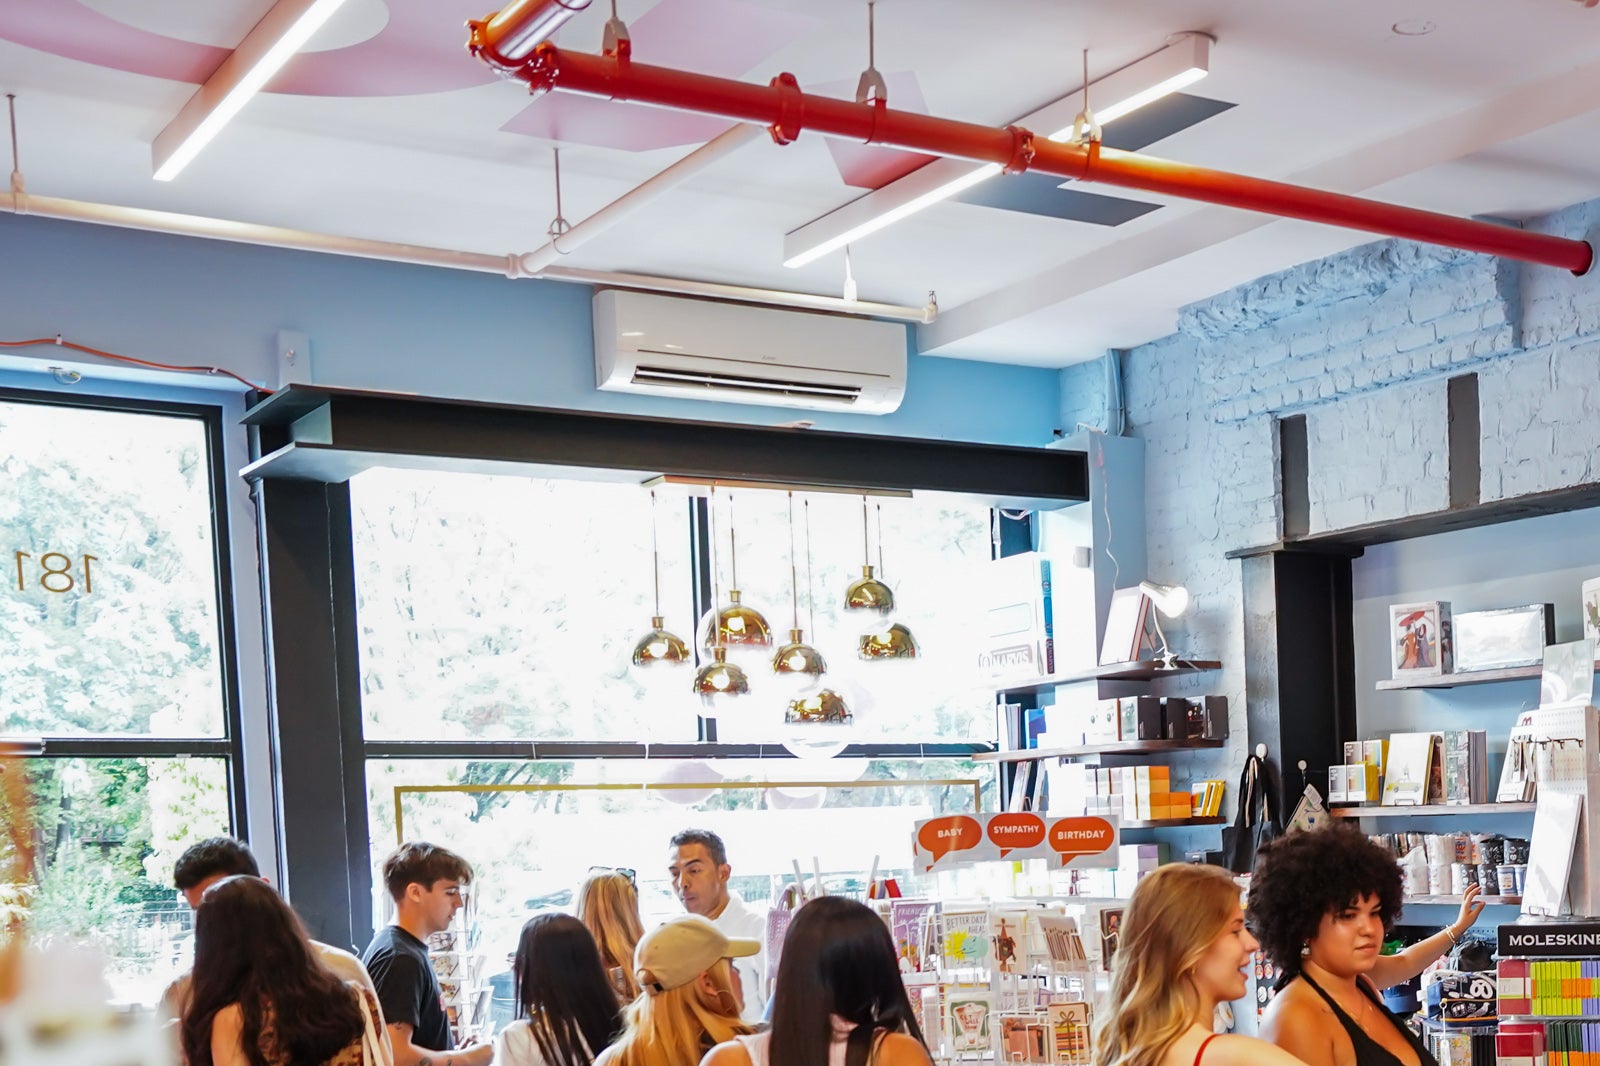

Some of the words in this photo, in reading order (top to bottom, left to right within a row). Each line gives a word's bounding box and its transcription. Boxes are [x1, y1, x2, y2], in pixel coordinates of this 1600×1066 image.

[937, 827, 963, 839] BABY
[993, 824, 1040, 835] SYMPATHY
[1057, 829, 1105, 841] BIRTHDAY
[946, 916, 970, 931] BETTER
